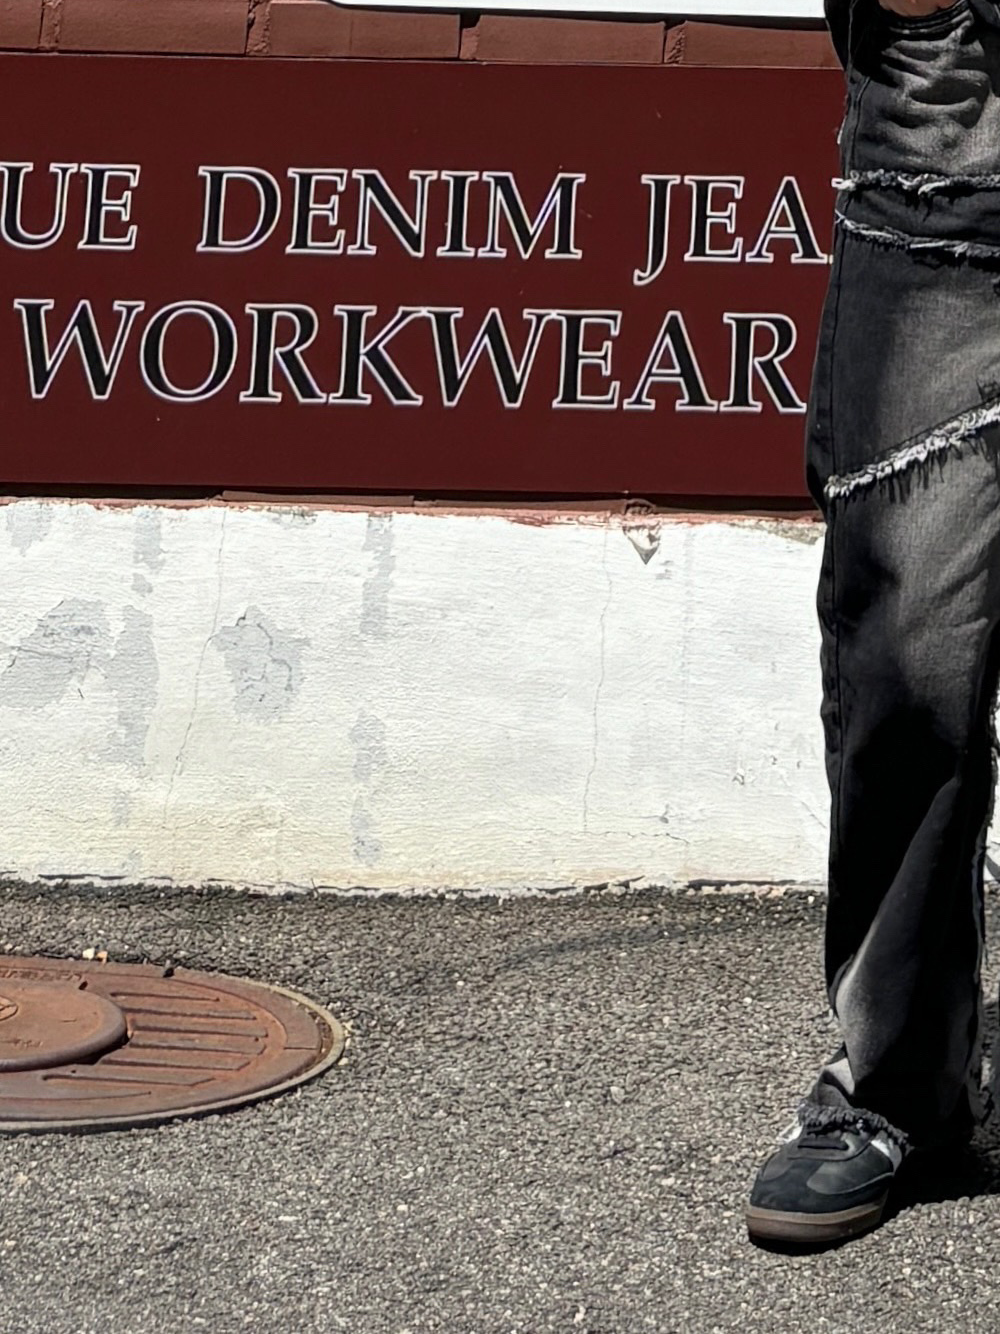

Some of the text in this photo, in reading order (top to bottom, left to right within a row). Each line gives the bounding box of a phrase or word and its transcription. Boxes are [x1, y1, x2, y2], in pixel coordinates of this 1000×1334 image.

[0, 162, 834, 287] UE DENIM JEA
[13, 298, 808, 415] WORKWEAR
